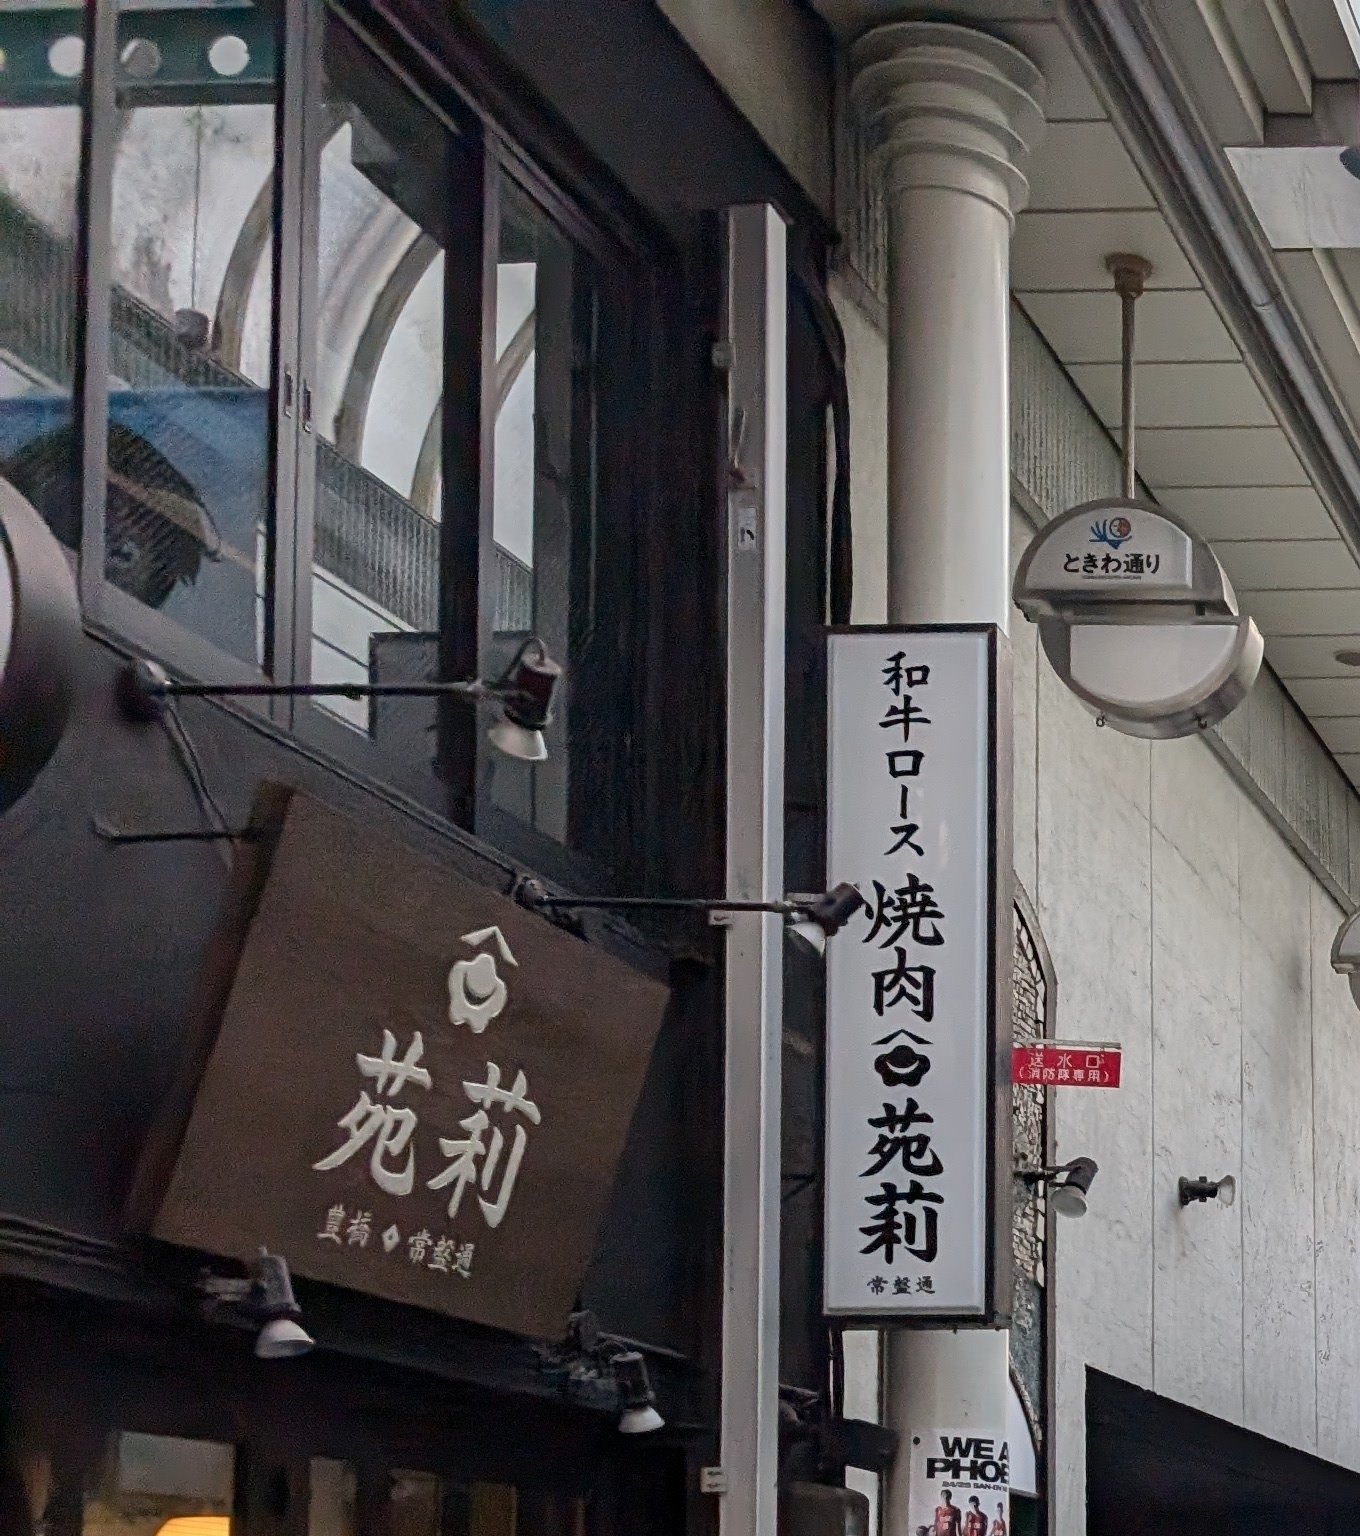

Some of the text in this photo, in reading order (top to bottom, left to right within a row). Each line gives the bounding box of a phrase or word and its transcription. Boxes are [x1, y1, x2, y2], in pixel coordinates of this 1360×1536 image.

[1063, 553, 1160, 574] ときわ通り
[878, 650, 932, 857] 和牛ロース
[861, 878, 946, 1023] 焼肉
[1027, 1051, 1100, 1069] 送水口
[313, 1028, 541, 1228] 苑莉
[858, 1101, 945, 1266] 苑莉
[866, 1274, 937, 1296] 常盤通
[940, 1436, 994, 1460] WE
